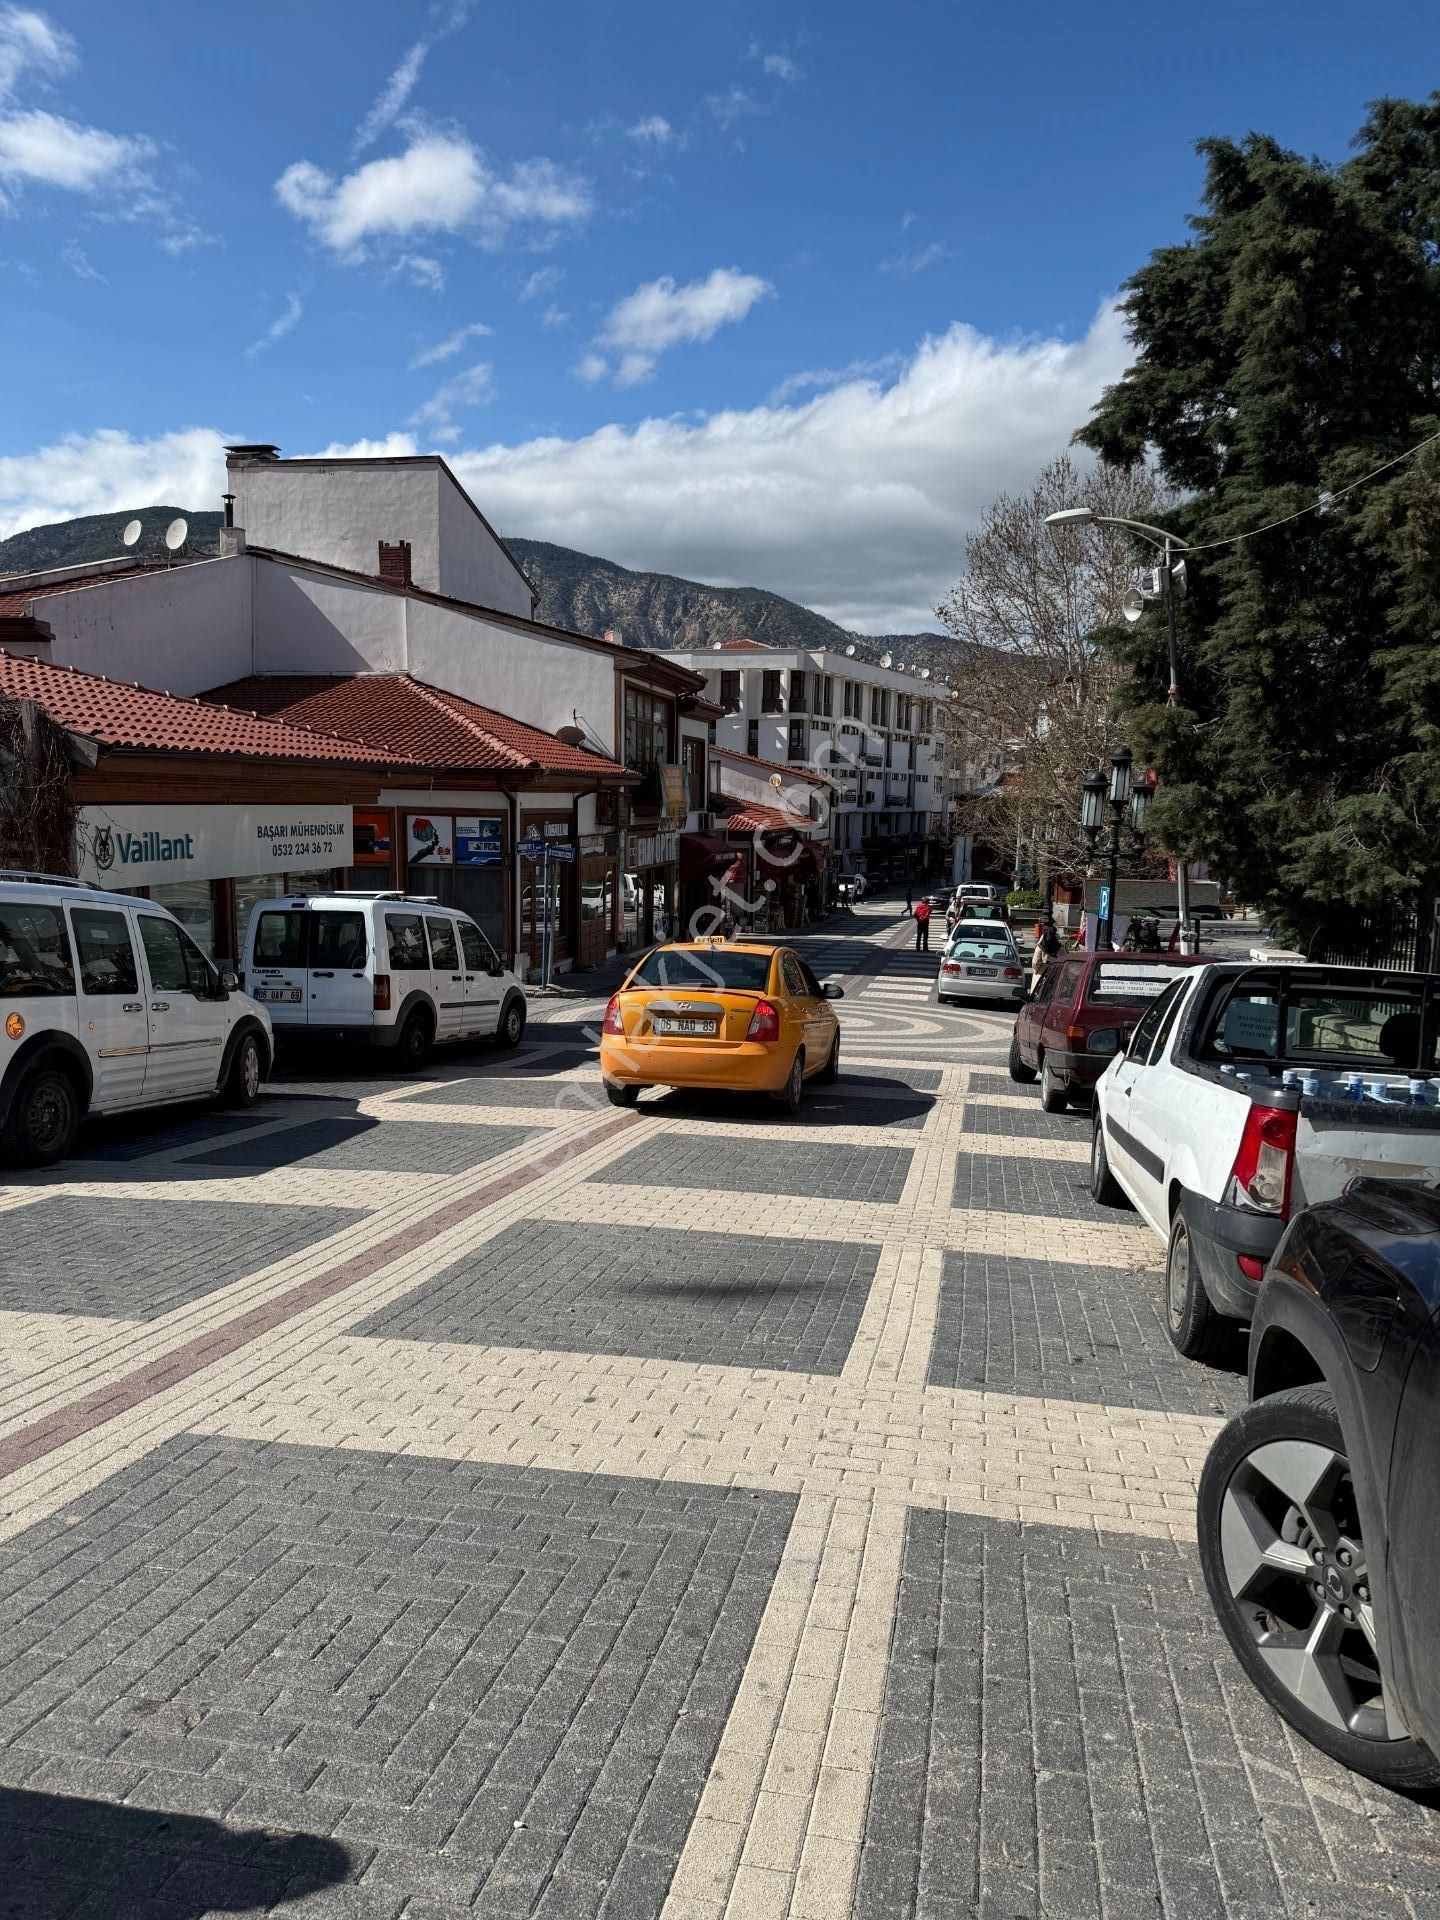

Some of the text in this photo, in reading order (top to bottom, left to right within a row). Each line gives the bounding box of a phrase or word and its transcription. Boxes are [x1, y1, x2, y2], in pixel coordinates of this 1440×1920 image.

[257, 821, 345, 842] BAŞARI MÜHENDİSLİK
[116, 832, 194, 863] Vaillant
[272, 842, 333, 857] 0532 234 36 72
[660, 1019, 714, 1032] 06 NAD 89
